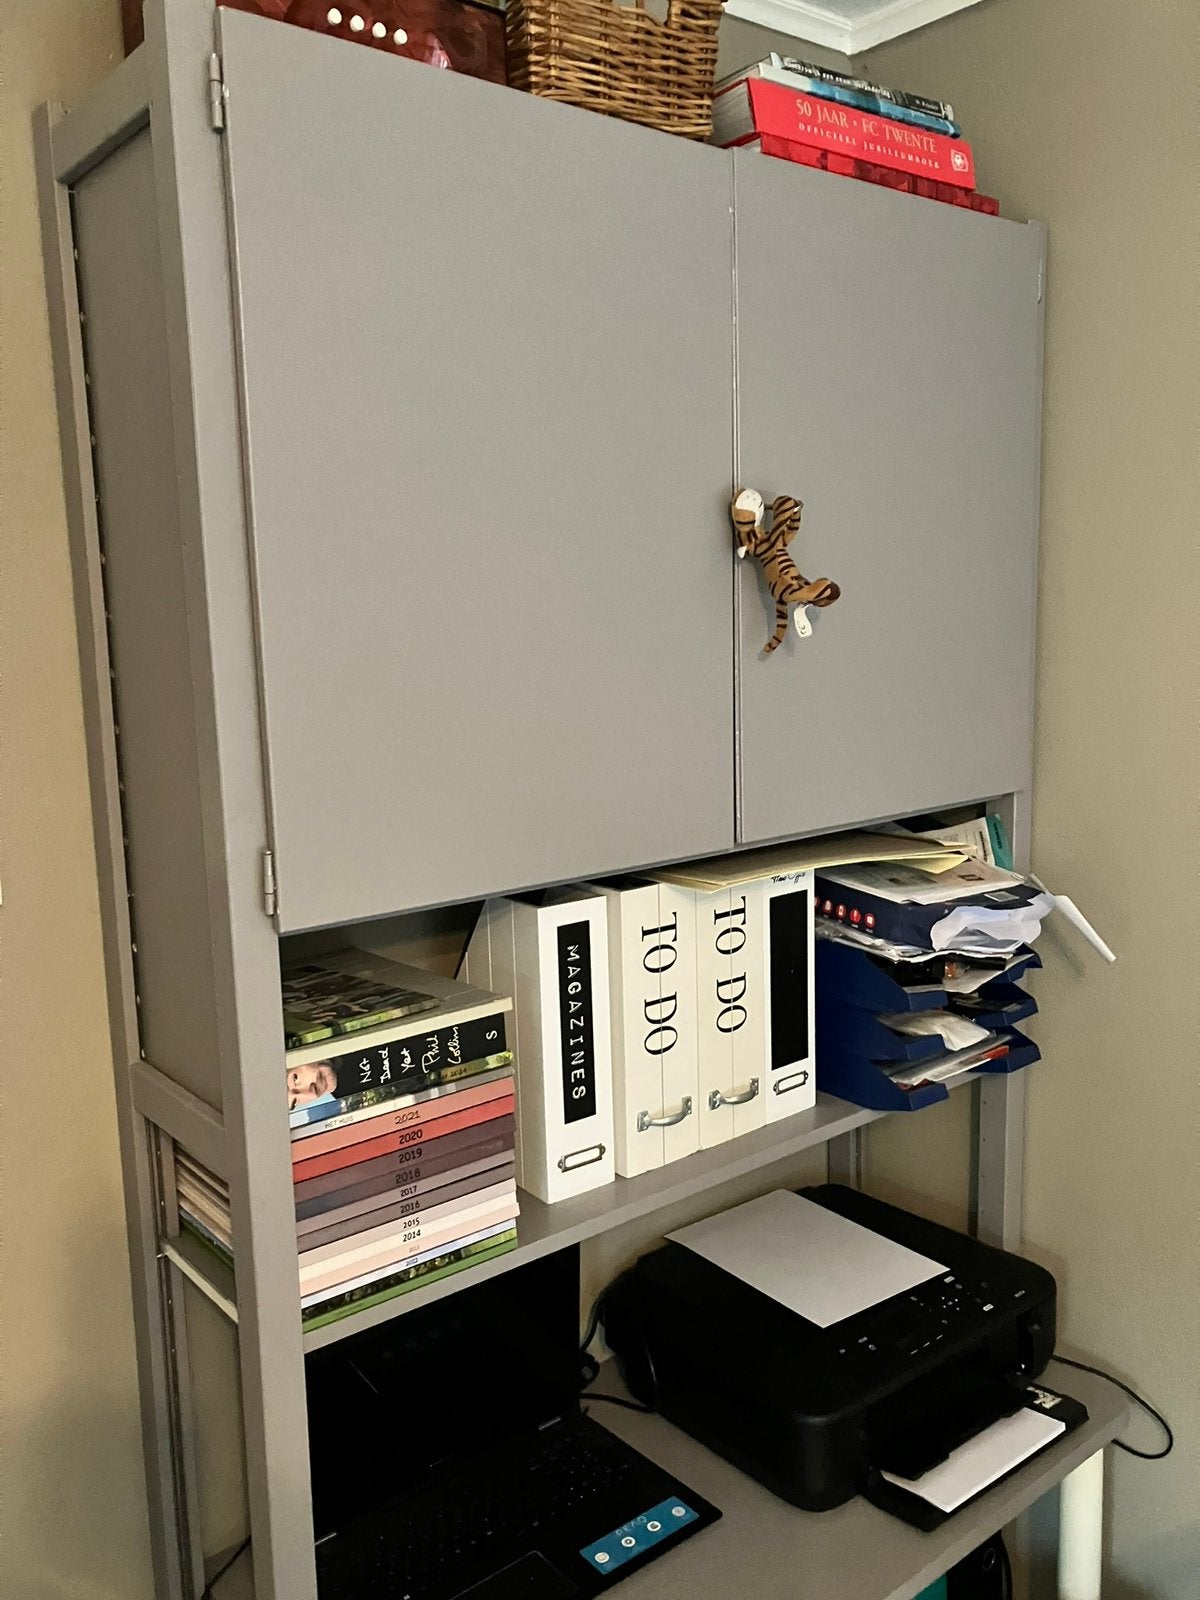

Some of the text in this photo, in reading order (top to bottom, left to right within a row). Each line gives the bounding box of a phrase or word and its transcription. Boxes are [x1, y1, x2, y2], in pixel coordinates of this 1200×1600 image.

[796, 99, 938, 153] 50 JAAR FC TWENTE
[798, 122, 940, 169] OFFICIEEL JUBILEUMBOEK
[714, 896, 747, 1033] TO DO
[642, 911, 678, 1056] TO DO
[566, 944, 586, 1100] MAGAZINES
[359, 1057, 372, 1084] Not
[378, 1047, 391, 1084] Dead
[401, 1047, 415, 1073] Yet
[421, 1034, 441, 1073] Phil
[394, 1110, 421, 1125] 2021
[398, 1129, 423, 1145] 2020
[398, 1148, 423, 1163] 2019
[395, 1168, 421, 1184] 2018
[400, 1185, 418, 1197] 2017
[400, 1201, 420, 1214] 2016
[403, 1217, 420, 1229] 2015
[402, 1229, 421, 1243] 2014
